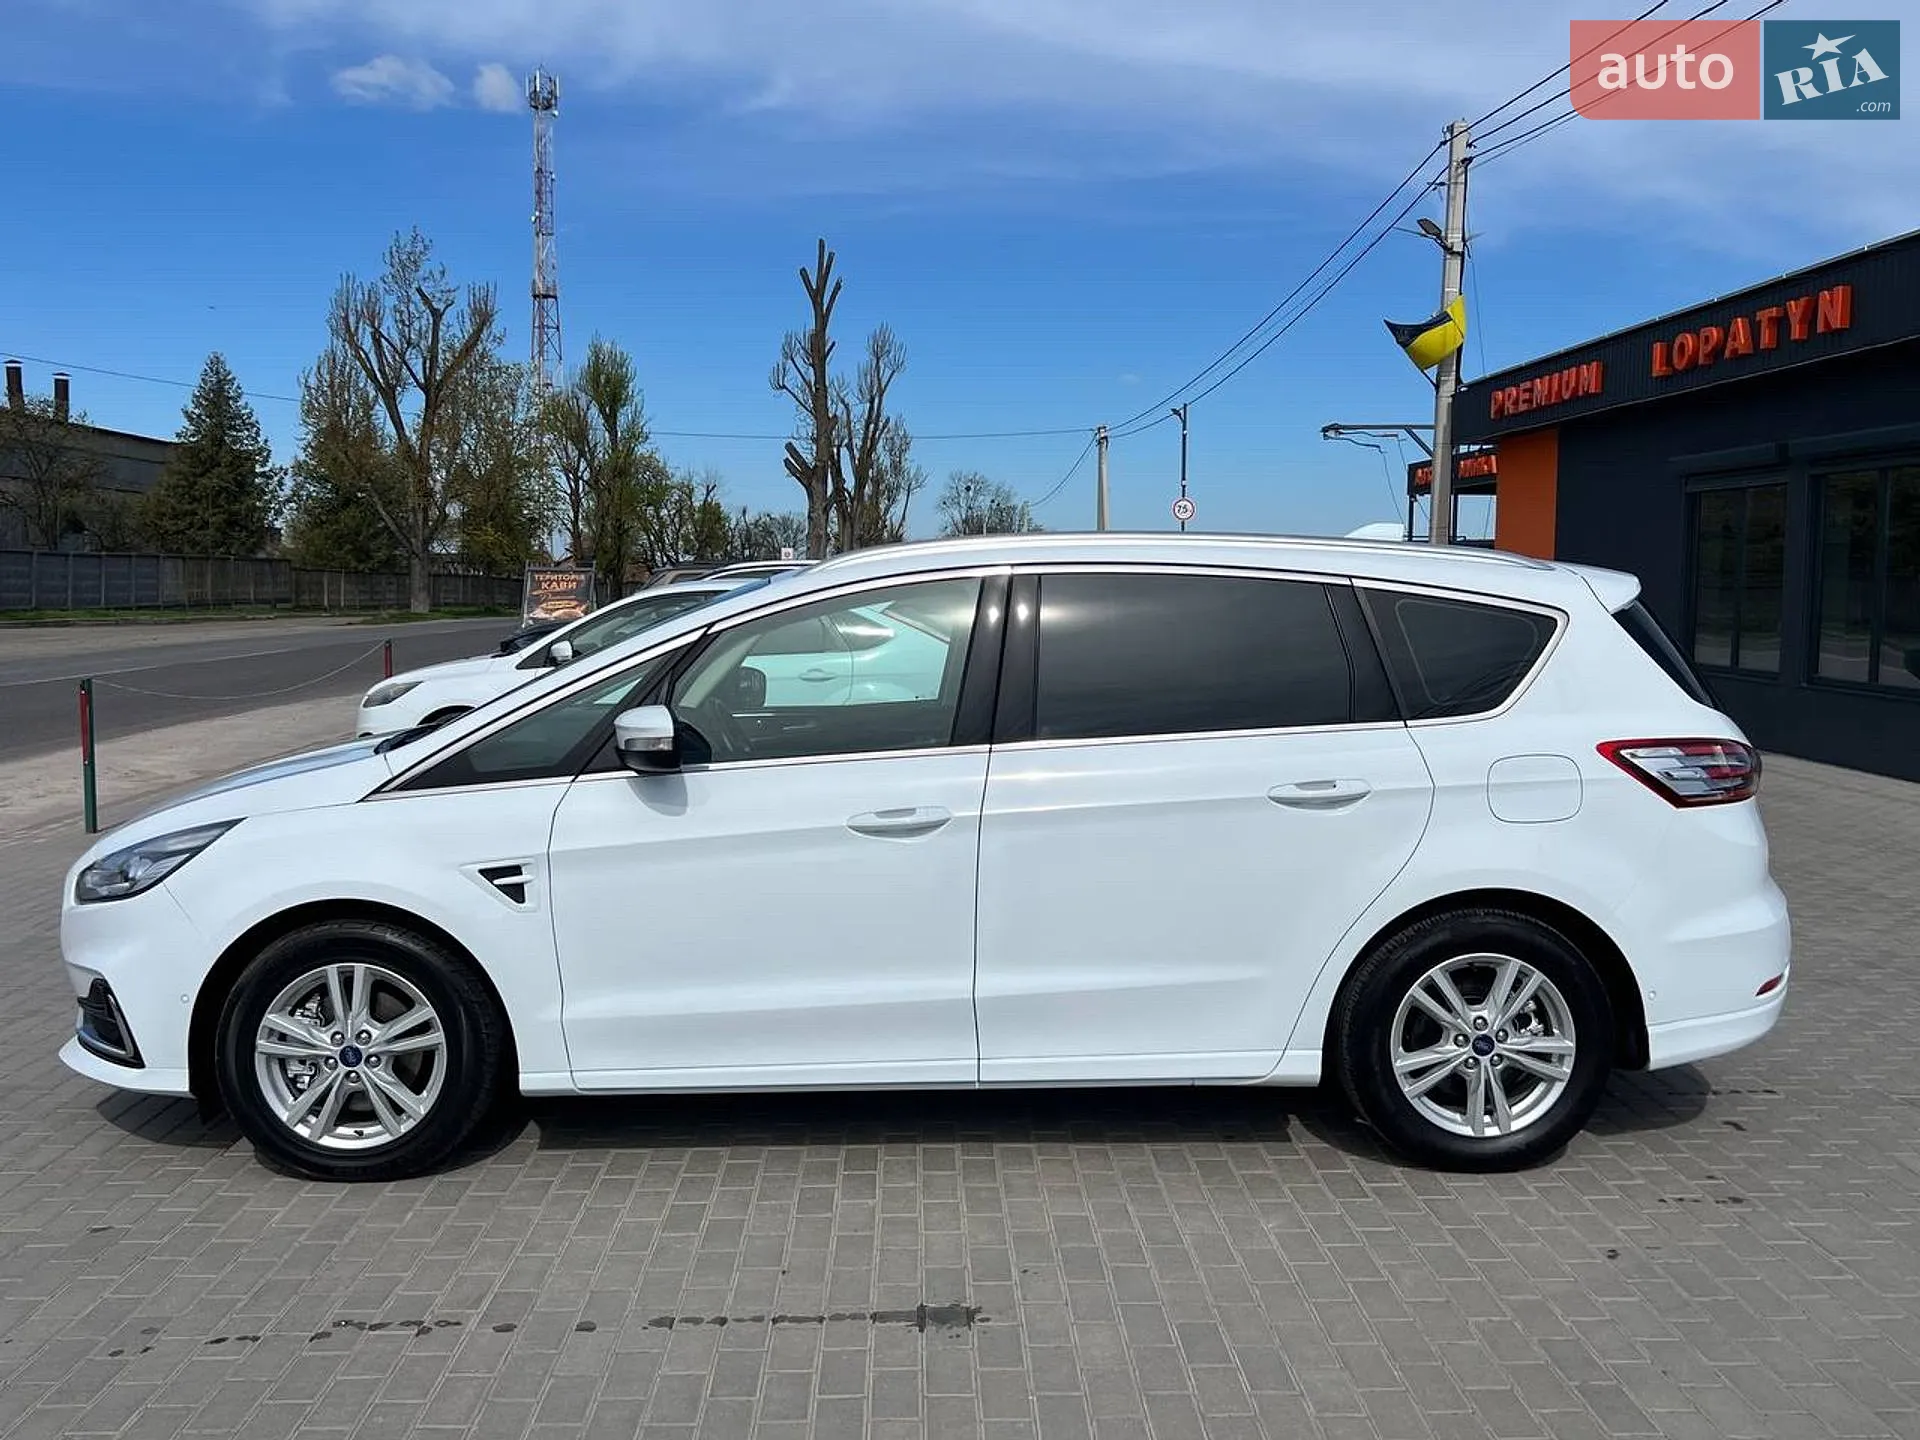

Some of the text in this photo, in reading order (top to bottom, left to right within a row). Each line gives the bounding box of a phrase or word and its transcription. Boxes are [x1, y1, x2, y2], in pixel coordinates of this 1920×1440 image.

[1490, 285, 1852, 420] PREMIUM LOPATYN
[541, 581, 577, 590] КАВИ
